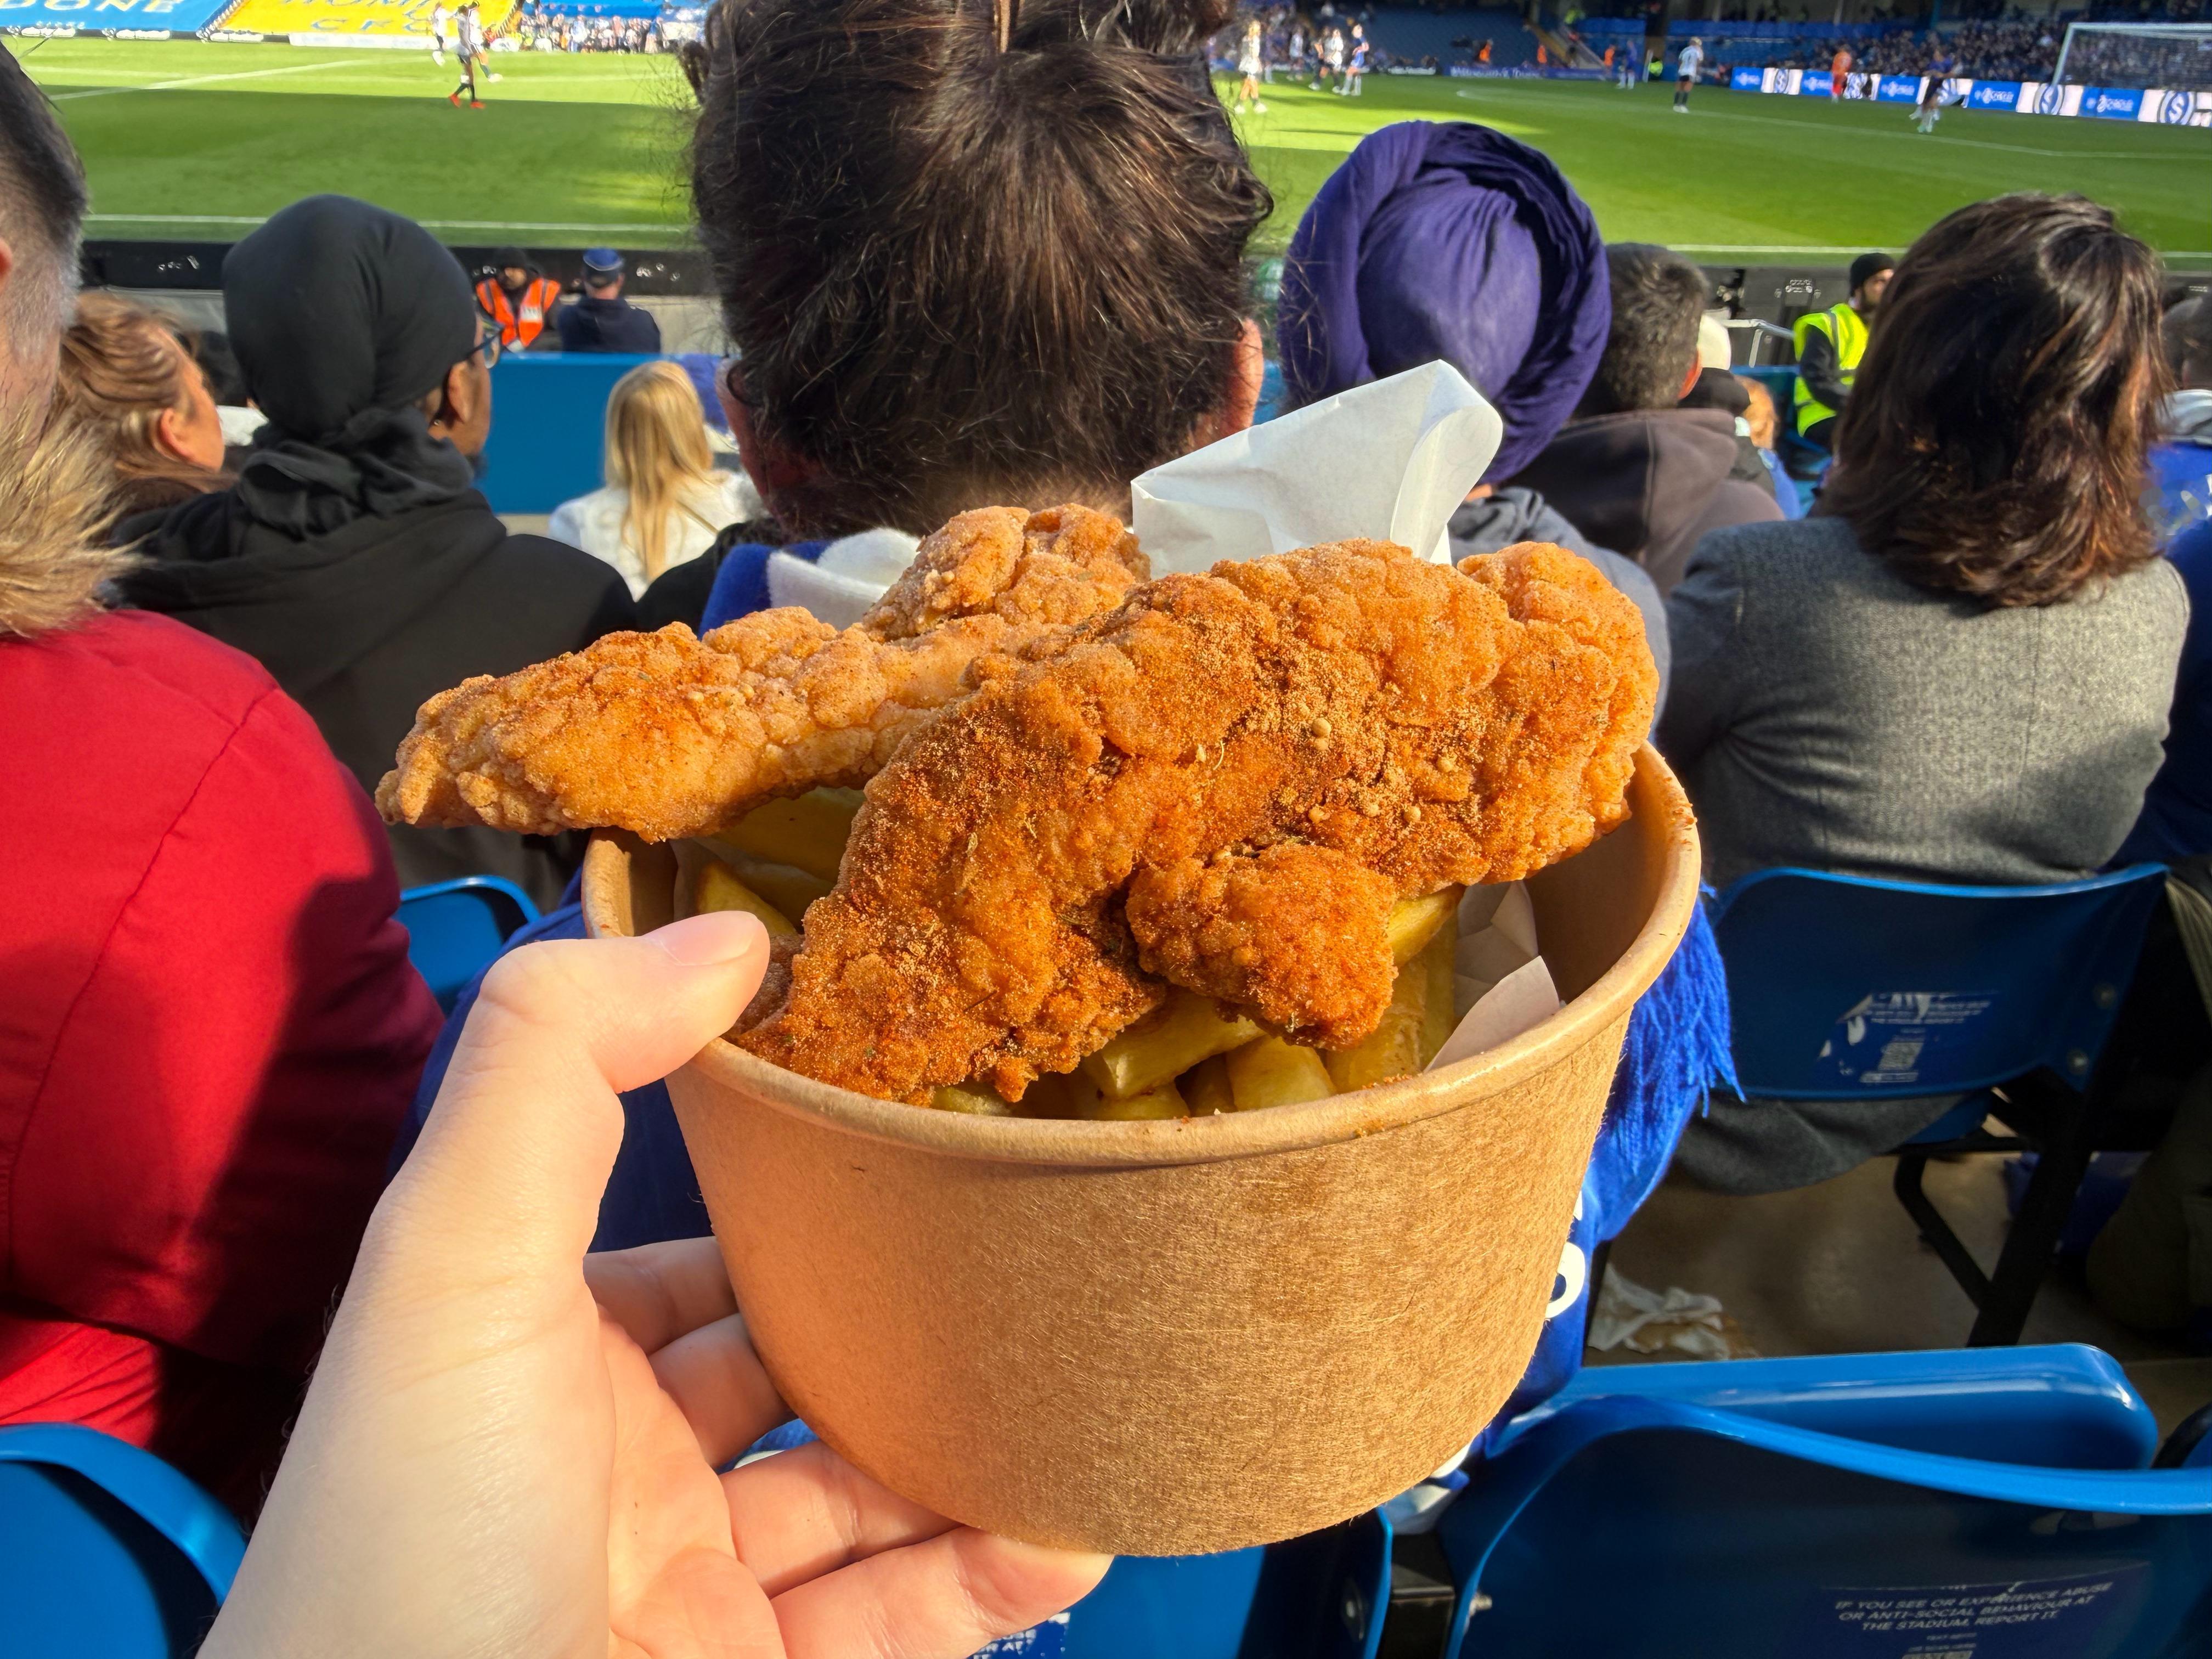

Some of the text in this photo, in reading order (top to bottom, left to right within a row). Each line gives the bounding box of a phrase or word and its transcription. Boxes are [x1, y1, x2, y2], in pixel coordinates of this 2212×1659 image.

[1858, 1600, 1894, 1610] YOU
[1895, 1599, 1928, 1608] SEE
[1931, 1598, 1956, 1607] OR
[1838, 1610, 1865, 1620] OR
[1867, 1608, 1974, 1619] ANTI-SOCIAL
[1863, 1622, 1893, 1630] THE
